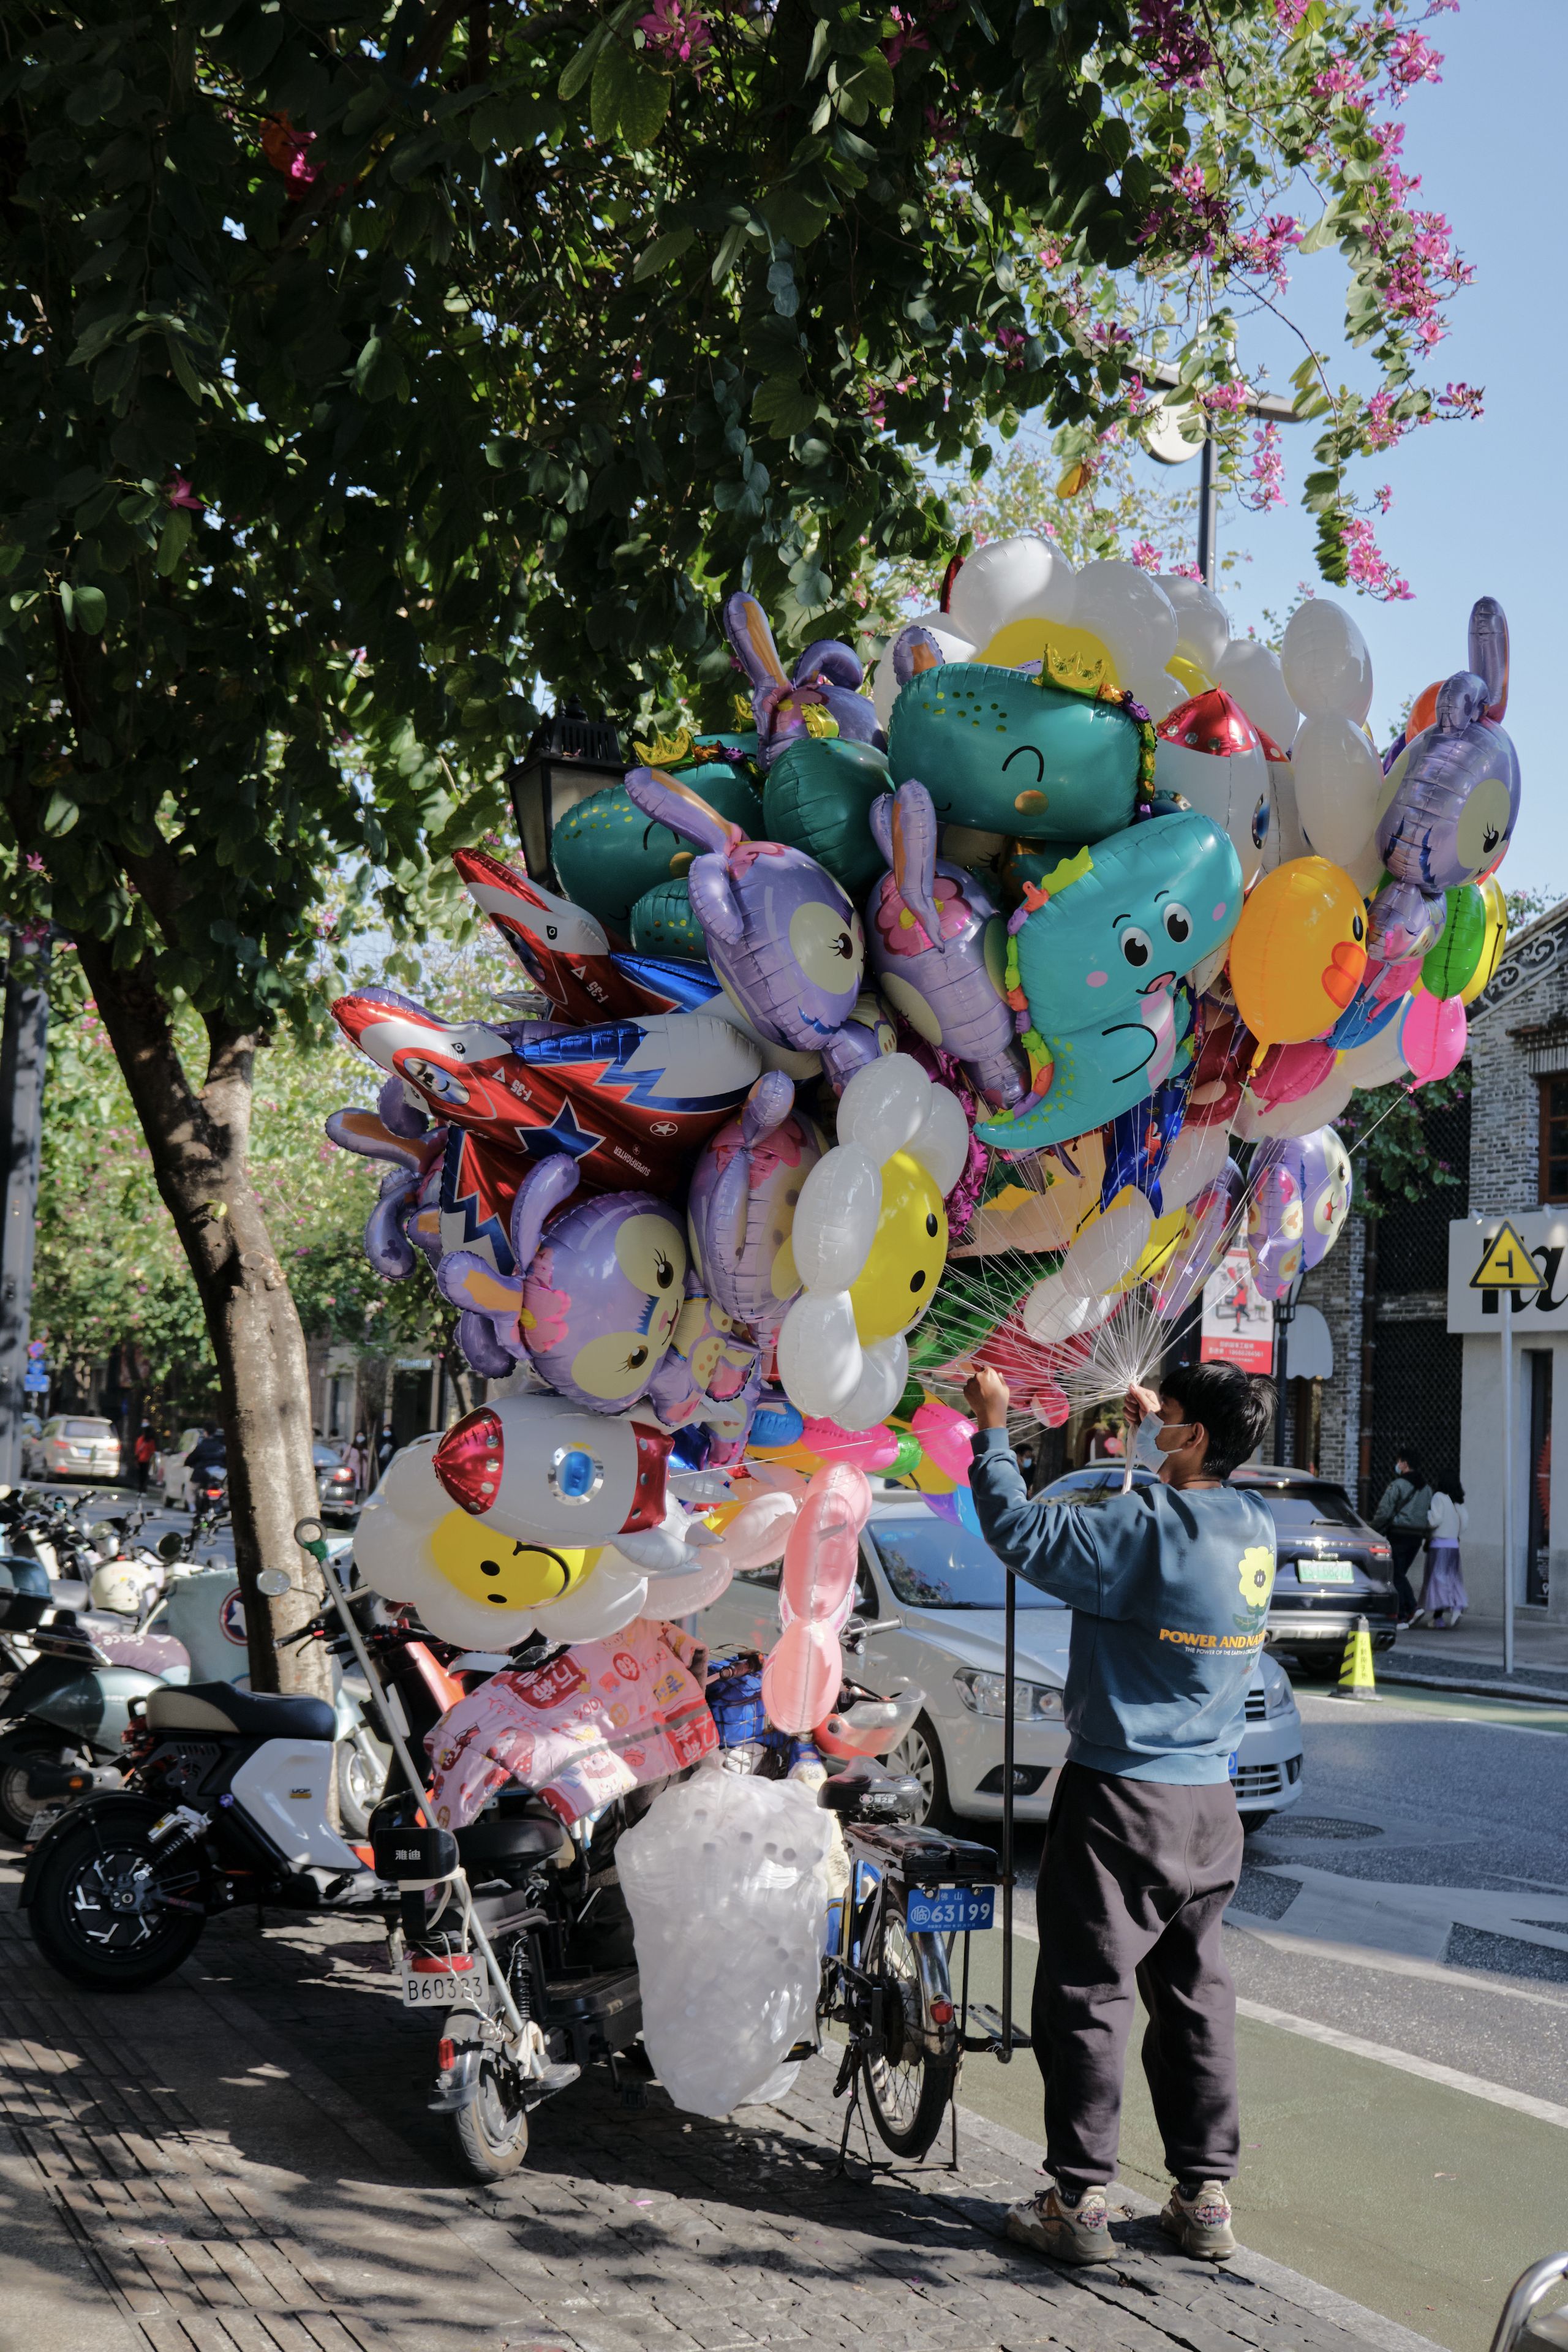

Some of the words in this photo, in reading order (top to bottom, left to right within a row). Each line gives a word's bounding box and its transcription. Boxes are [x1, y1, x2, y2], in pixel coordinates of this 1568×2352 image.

[586, 981, 609, 1003] F-35
[510, 1079, 533, 1102] F-35
[614, 1145, 650, 1177] SUPERFIGHTER
[1159, 1629, 1217, 1648] POWER
[1219, 1636, 1246, 1648] AND
[395, 1849, 421, 1860] 雅迪
[931, 1903, 990, 1923] 63199
